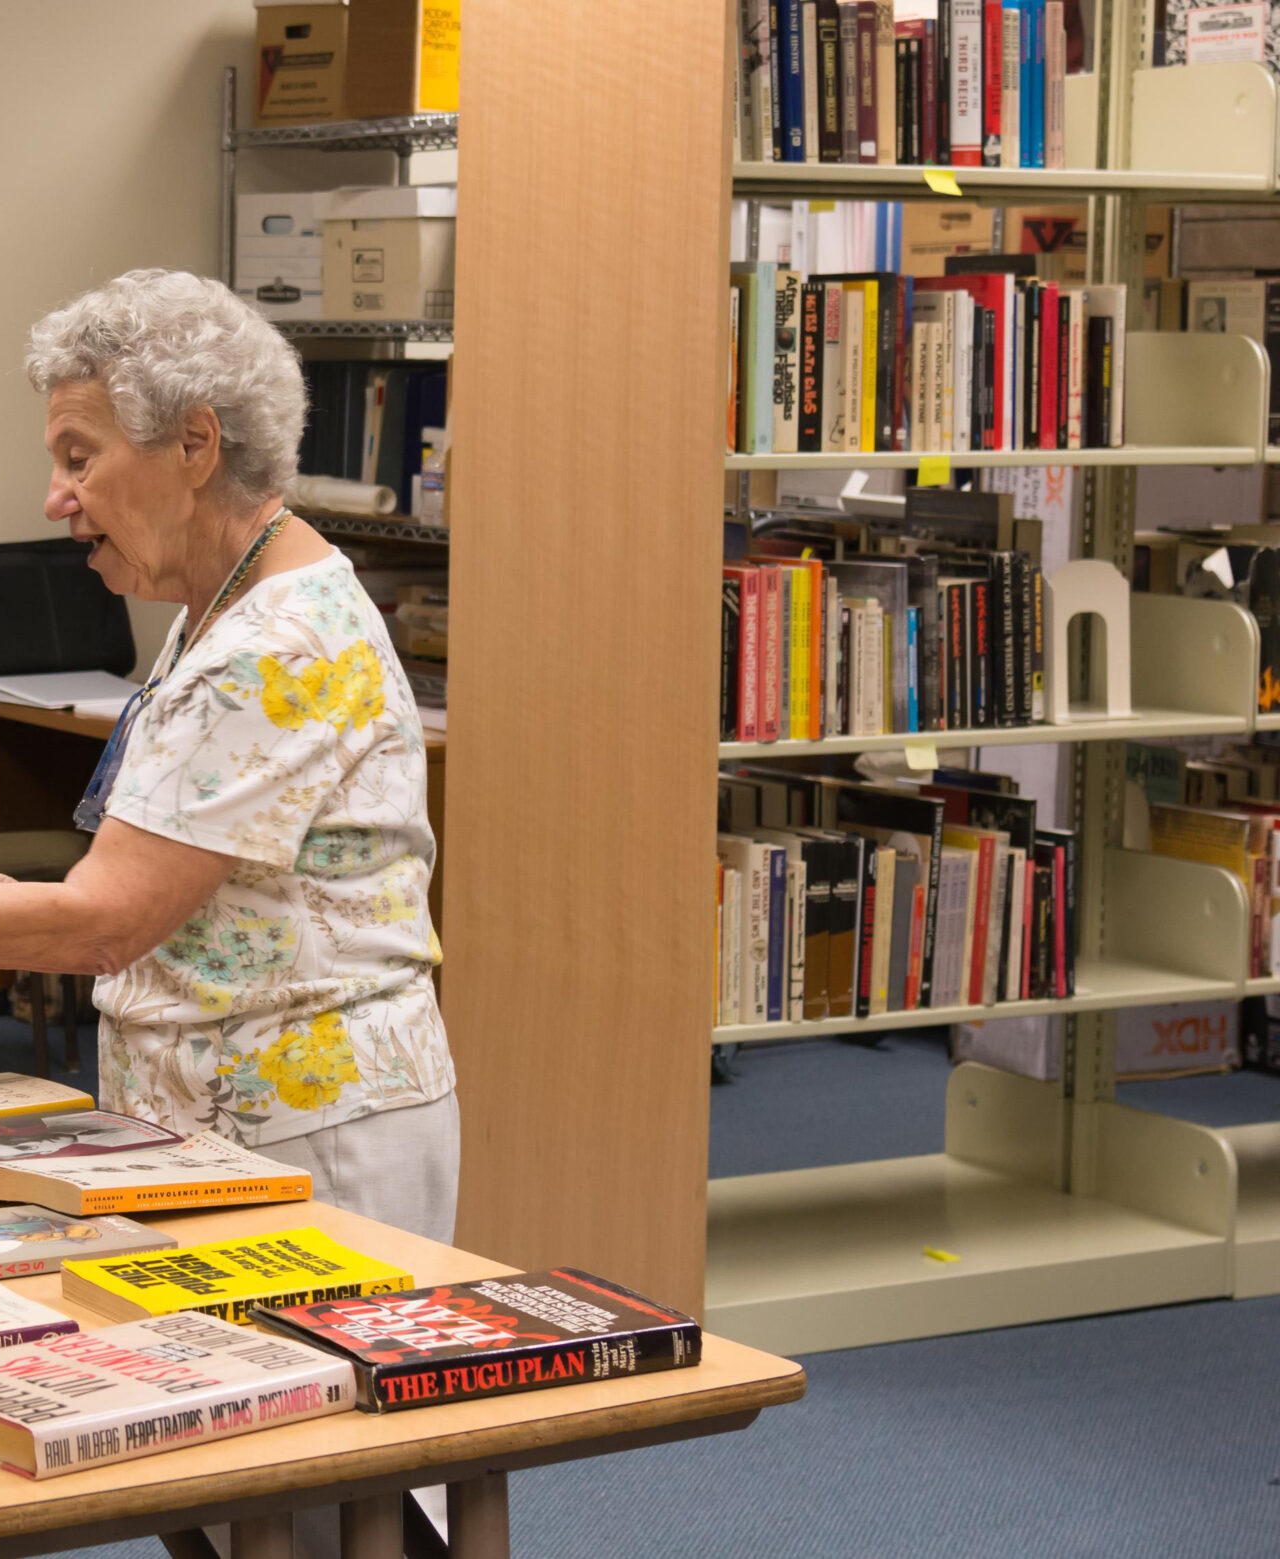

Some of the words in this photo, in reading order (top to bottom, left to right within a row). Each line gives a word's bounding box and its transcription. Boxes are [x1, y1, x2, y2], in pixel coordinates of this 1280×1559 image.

[958, 35, 968, 72] THIRD
[958, 80, 968, 117] REICH
[775, 290, 788, 327] math
[786, 276, 798, 316] After
[918, 343, 926, 381] PLAYING
[934, 343, 942, 381] PLAYING
[773, 354, 788, 405] Farago
[784, 363, 796, 421] Ladislas
[745, 594, 756, 613] THE
[766, 592, 777, 610] THE
[745, 616, 756, 644] NEW
[766, 615, 777, 642] NEW
[752, 870, 760, 889] AND
[752, 894, 760, 911] THE
[751, 915, 760, 938] JEWS
[86, 1195, 124, 1203] ALEXANDER
[136, 1189, 199, 1199] BENEVOLENCE
[204, 1187, 222, 1196] AND
[226, 1184, 270, 1194] BETRAYAL
[222, 1253, 267, 1270] Story
[231, 1245, 281, 1265] Jewish
[265, 1247, 334, 1276] Resistance
[269, 1237, 327, 1260] Europe
[97, 1261, 171, 1289] THEY
[128, 1256, 229, 1296] FOUGHT
[160, 1252, 236, 1281] BACK
[251, 1268, 283, 1278] The
[266, 1263, 297, 1273] the
[307, 1258, 348, 1271] Nazi
[312, 1284, 362, 1303] BACK
[128, 1315, 262, 1351] HILBERG
[327, 1321, 395, 1343] THE
[328, 1302, 468, 1351] FUGU
[375, 1296, 520, 1345] PLAN
[23, 1332, 232, 1394] BYSTANDERS
[214, 1340, 326, 1369] RAUL
[592, 1342, 601, 1377] Marvin
[601, 1341, 610, 1377] Tokayer
[610, 1348, 619, 1366] and
[619, 1344, 627, 1369] Mary
[627, 1339, 636, 1371] Swartz
[380, 1373, 439, 1404] THE
[443, 1362, 513, 1396] FUGU
[516, 1350, 586, 1385] PLAN
[45, 1437, 75, 1470] RAUL
[77, 1428, 120, 1462] HILBERG
[125, 1408, 204, 1451] PERPETRATORS
[210, 1398, 254, 1433] VICTIMS
[258, 1383, 322, 1424] BYSTANDERS
